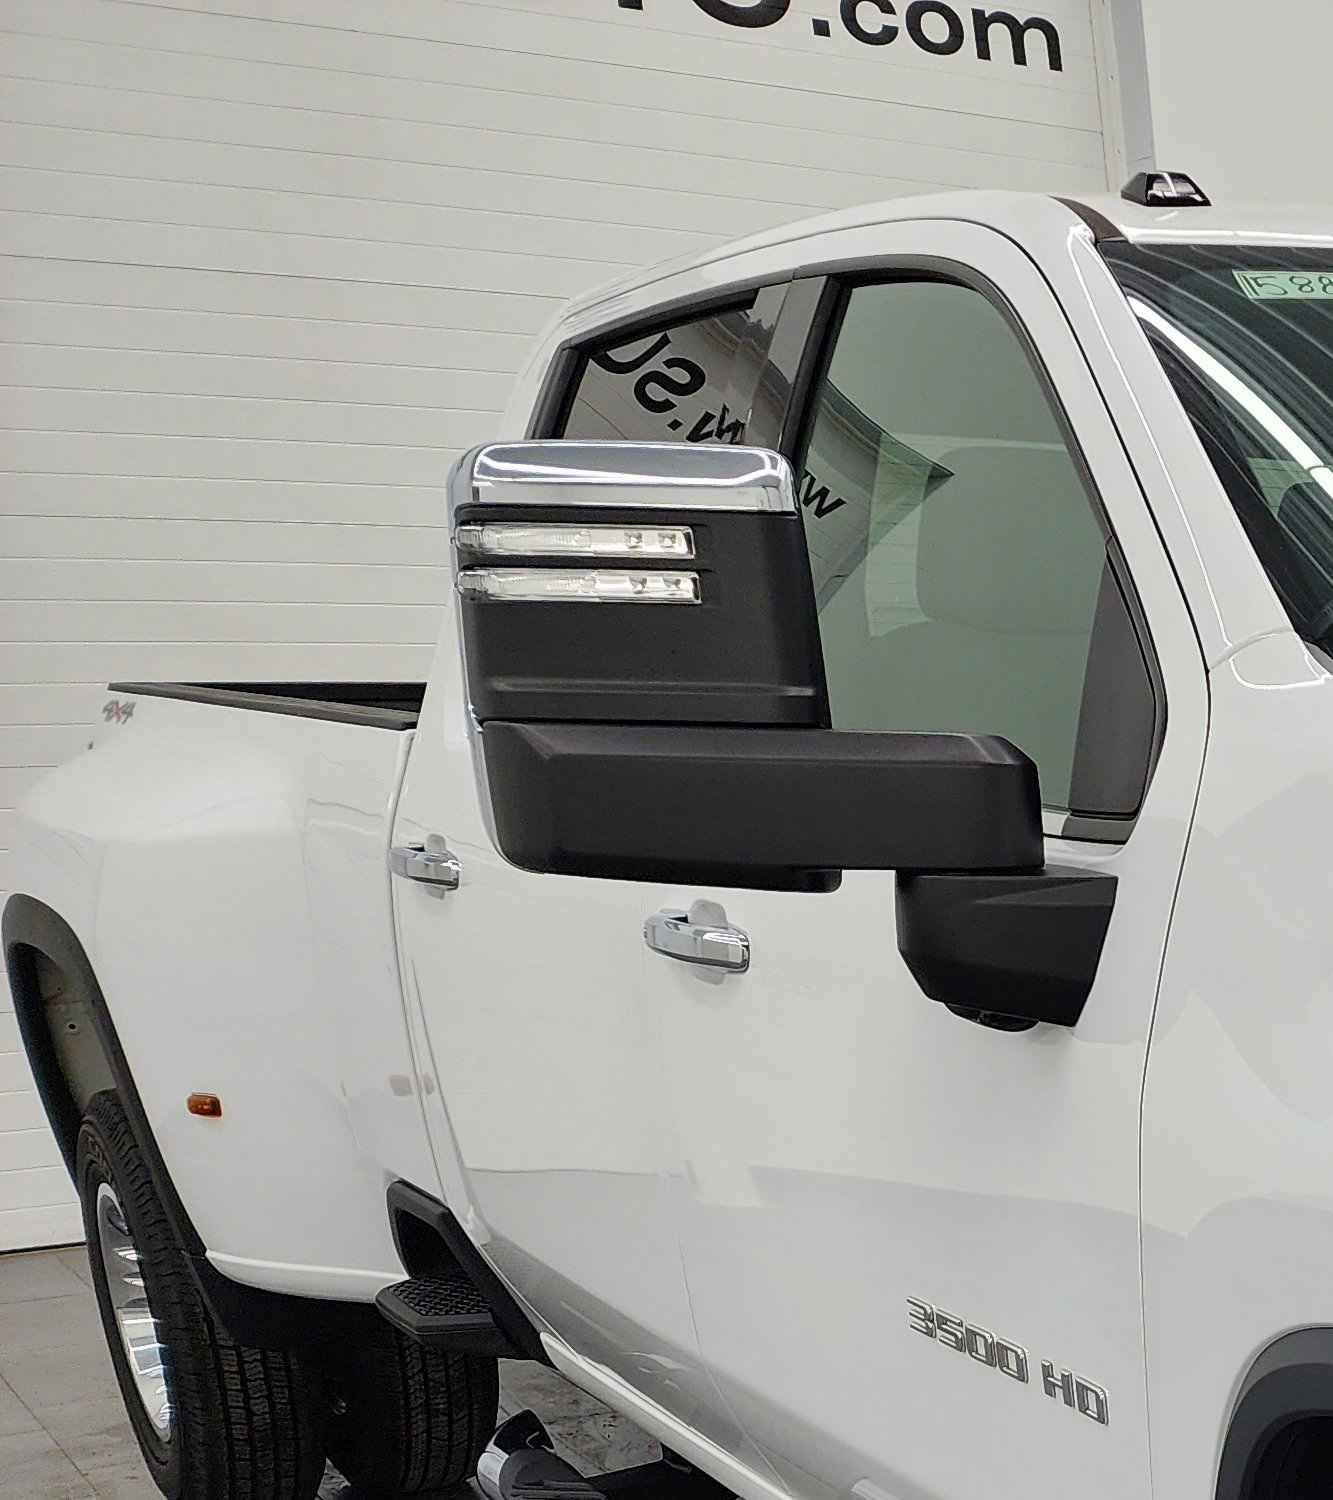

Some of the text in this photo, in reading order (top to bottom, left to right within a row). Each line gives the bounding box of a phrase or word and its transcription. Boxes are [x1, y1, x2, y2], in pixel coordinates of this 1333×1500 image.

[616, 0, 1063, 72] .com
[906, 1296, 1109, 1425] 3500 HD
